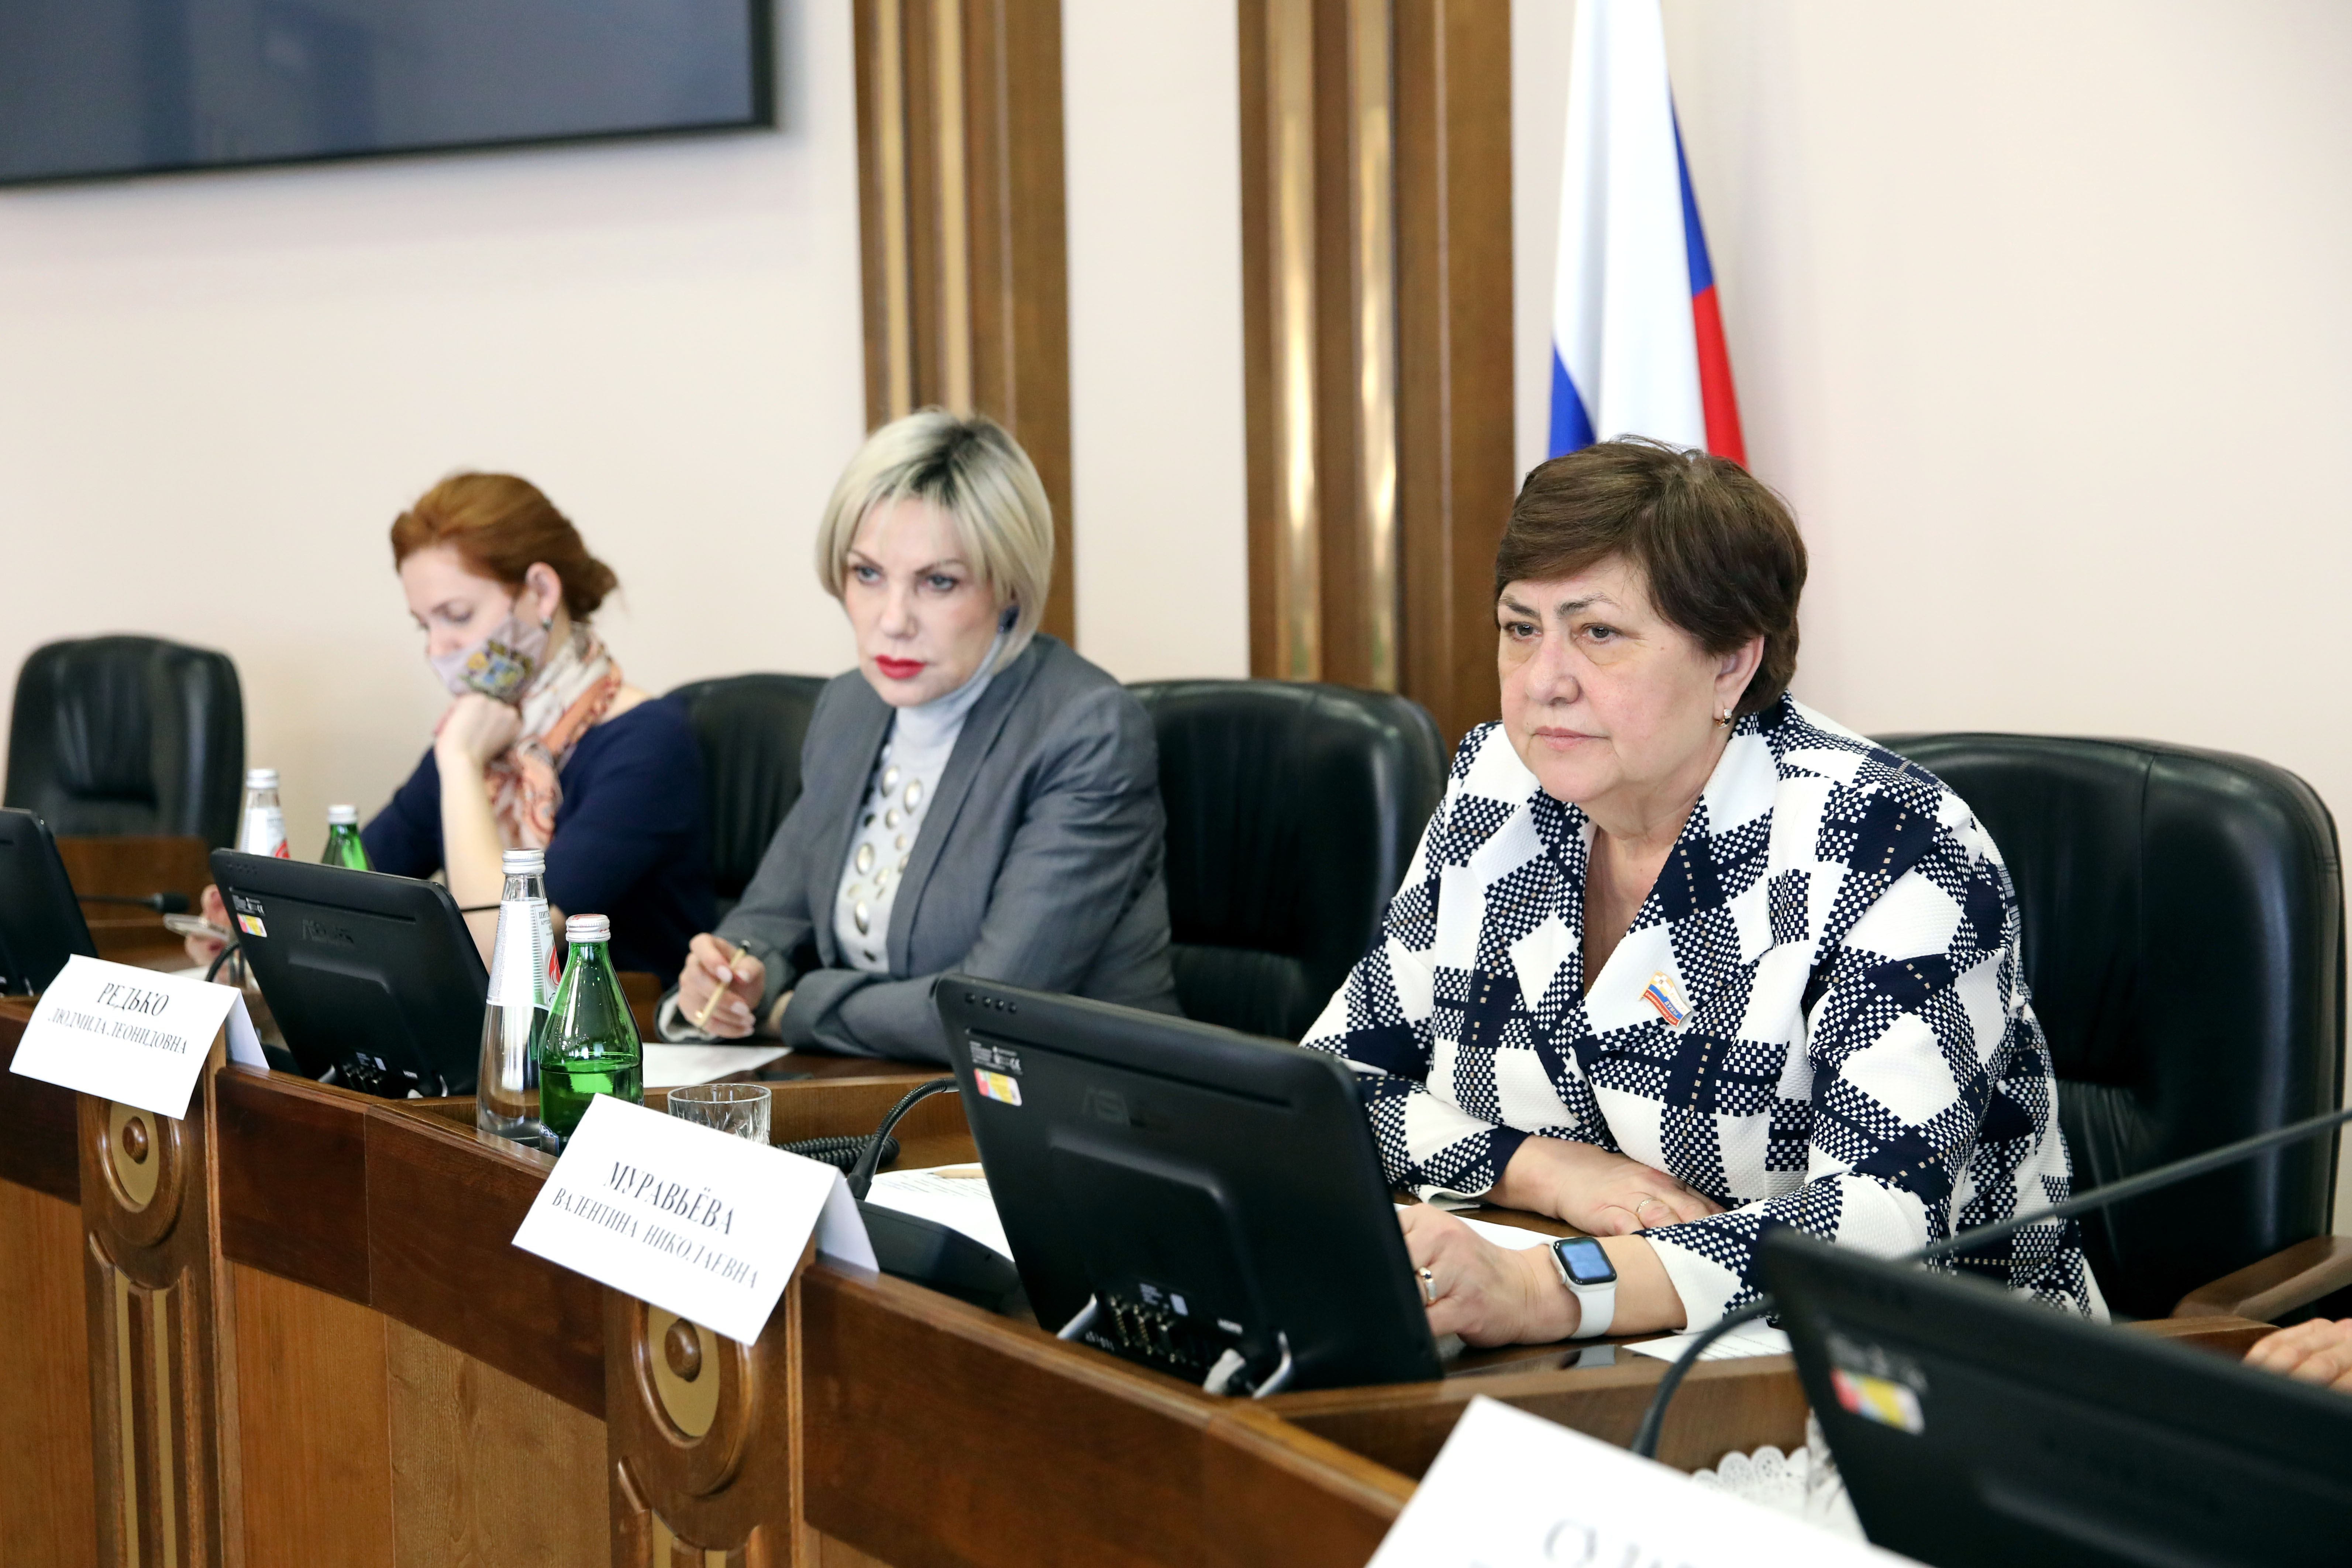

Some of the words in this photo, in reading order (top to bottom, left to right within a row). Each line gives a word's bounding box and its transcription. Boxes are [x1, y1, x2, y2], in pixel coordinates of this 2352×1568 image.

[97, 982, 169, 1016] РЕДЬКО
[1664, 1000, 1678, 1016] ДУМЫ
[48, 1008, 107, 1035] ЛЮДМИЛА
[107, 1021, 187, 1054] ЛЕОНИДОВНА
[603, 1161, 736, 1236] МУРАВЬЁВА
[552, 1187, 639, 1238] ВАЛЕНТИНА
[642, 1224, 759, 1289] НИКОЛАЕВНА
